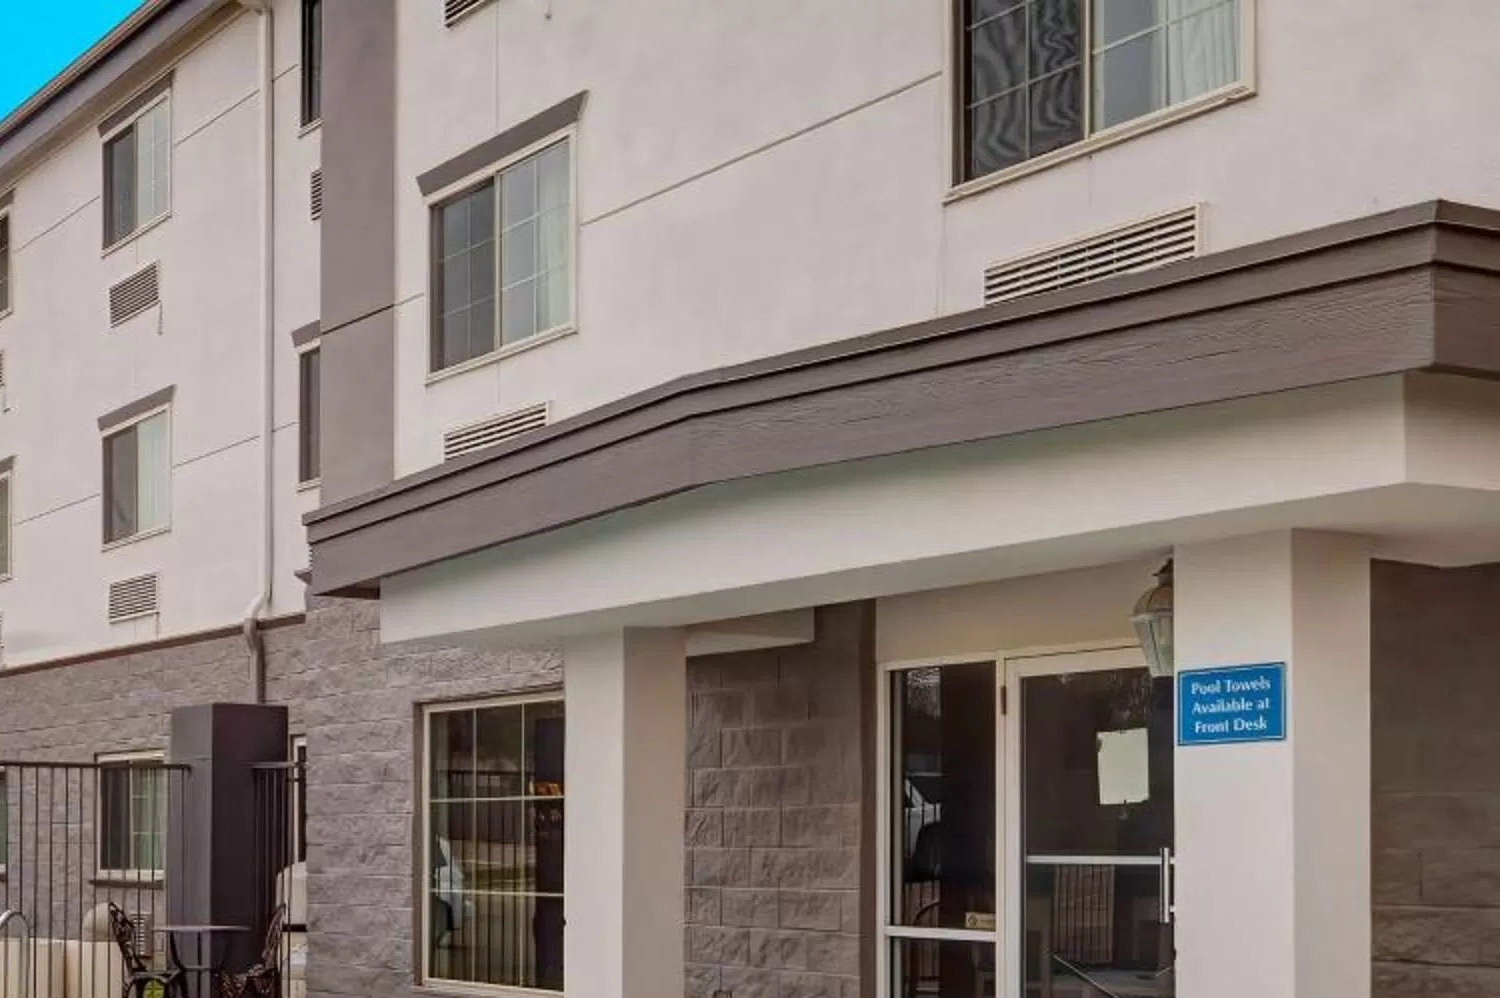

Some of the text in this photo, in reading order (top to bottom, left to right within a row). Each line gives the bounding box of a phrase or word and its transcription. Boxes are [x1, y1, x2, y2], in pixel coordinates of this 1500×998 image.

[1191, 676, 1271, 695] Pool Towels
[1192, 698, 1269, 715] Available at
[1195, 715, 1267, 733] Front Desk
